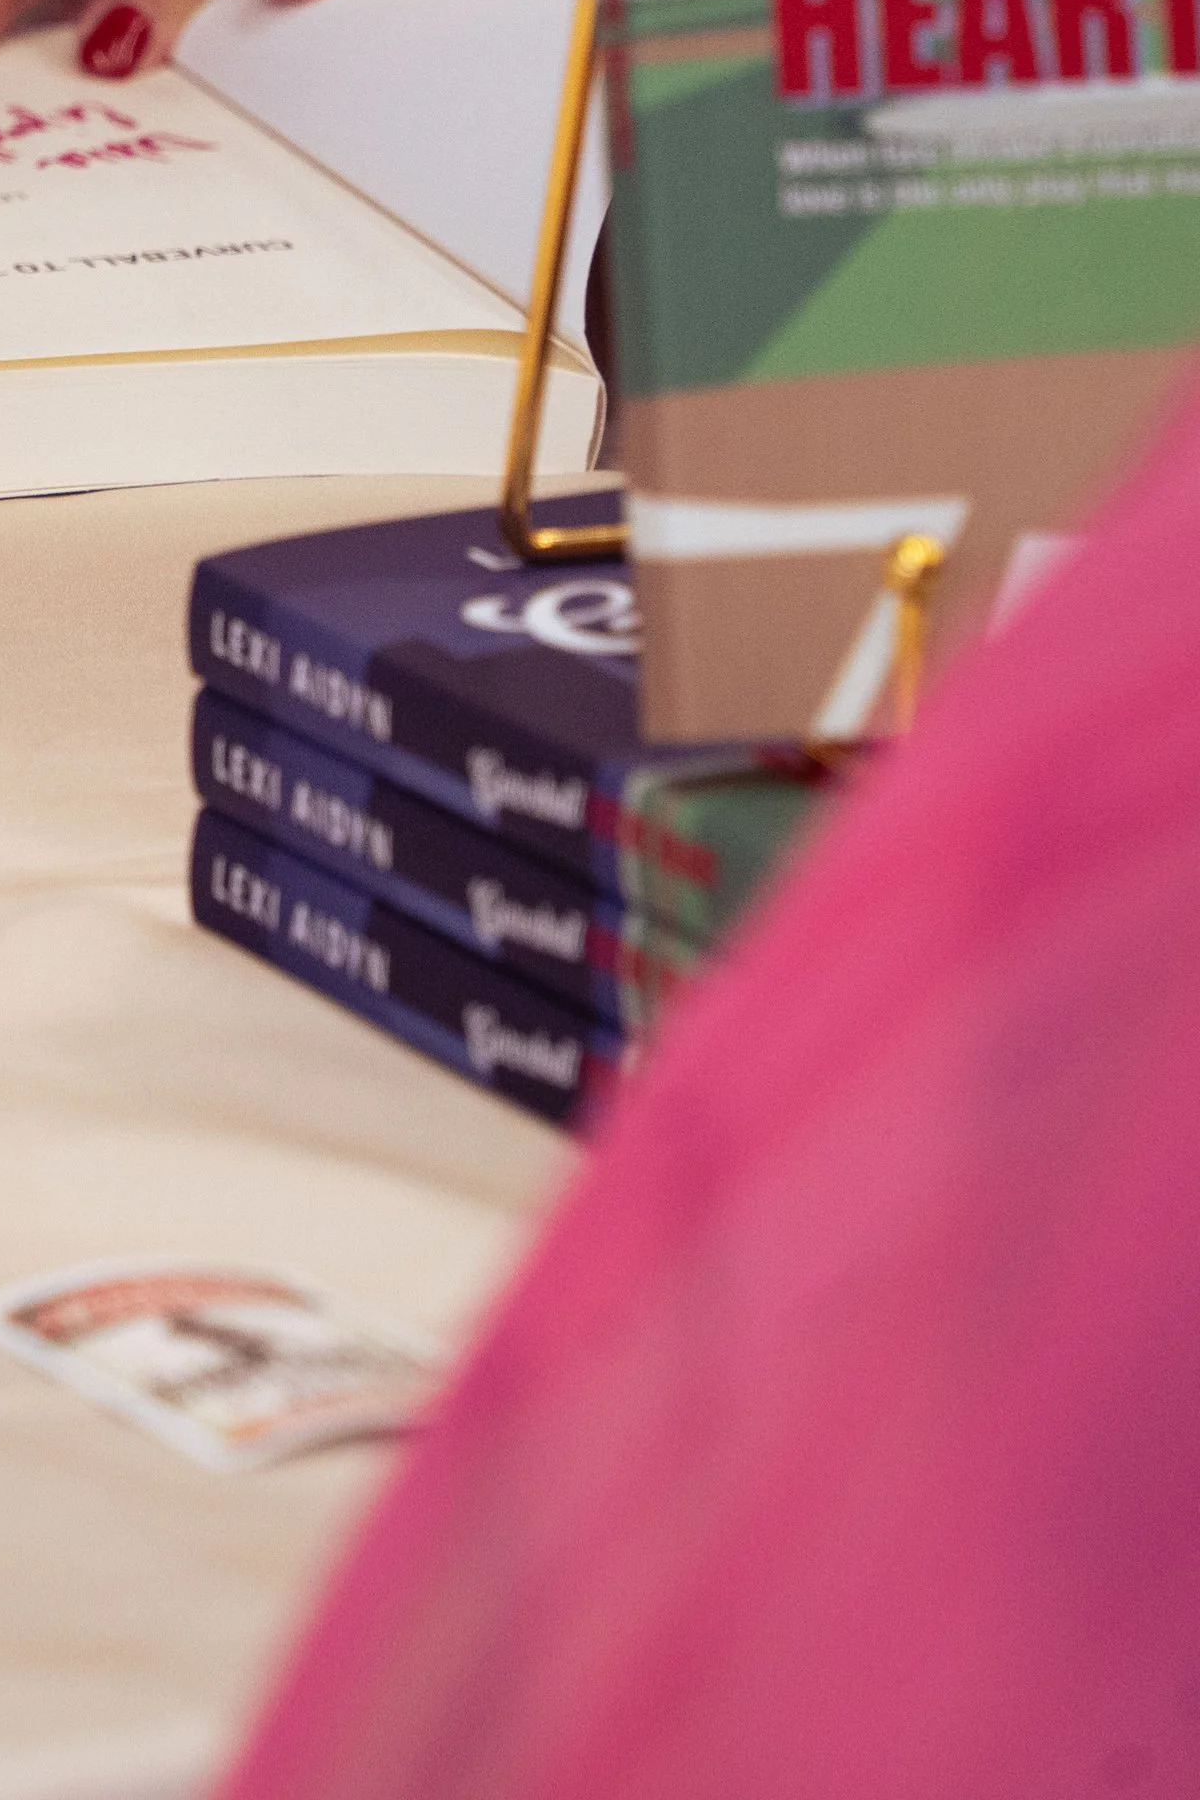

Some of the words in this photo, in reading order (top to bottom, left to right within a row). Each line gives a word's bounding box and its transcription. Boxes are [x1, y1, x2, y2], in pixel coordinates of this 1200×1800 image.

[14, 259, 67, 277] TO
[71, 237, 294, 268] CURVEBALL
[209, 610, 281, 682] LEXI
[289, 650, 393, 741] AIDYN
[210, 735, 282, 809] LEXI
[290, 780, 393, 869] AIDYN
[209, 853, 281, 929] LEXI
[288, 902, 391, 993] AIDYN
